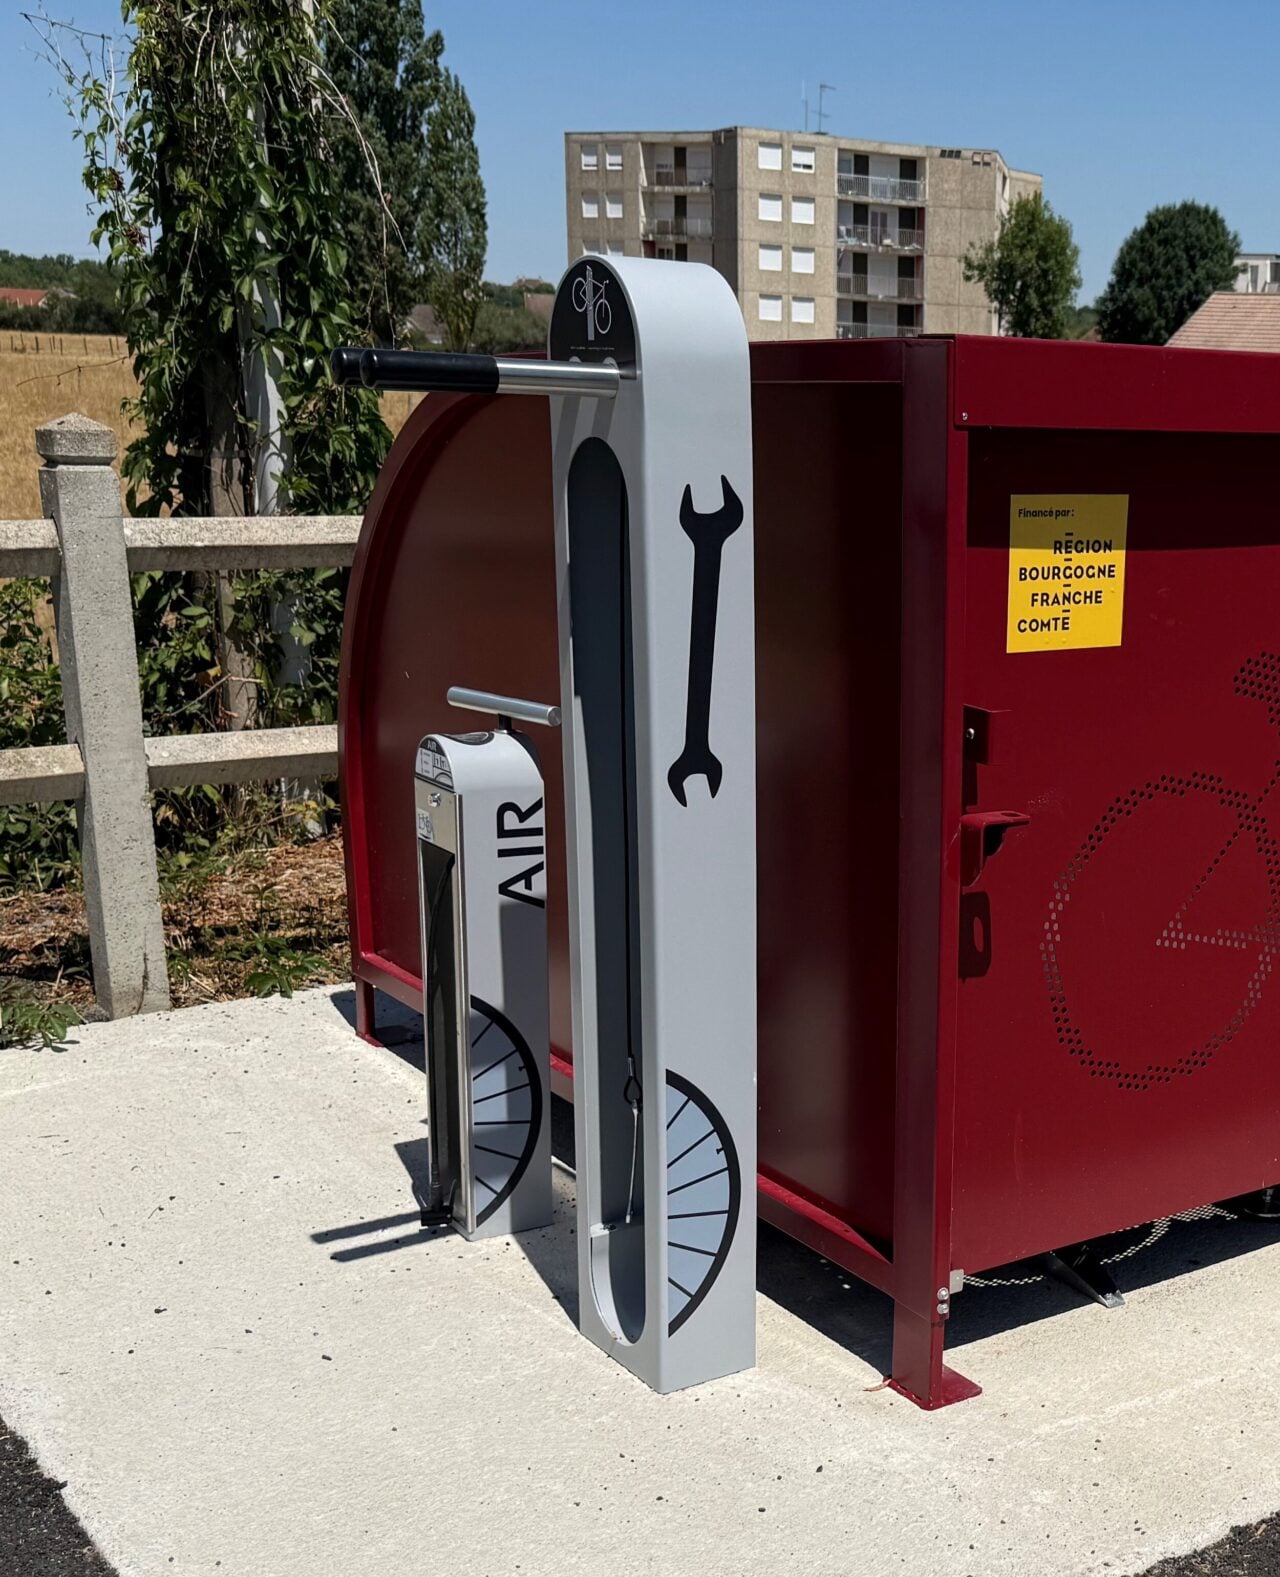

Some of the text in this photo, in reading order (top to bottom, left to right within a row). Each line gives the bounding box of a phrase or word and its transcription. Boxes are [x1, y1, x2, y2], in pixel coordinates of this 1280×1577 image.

[1018, 564, 1116, 582] BOURGOGNE
[1030, 590, 1103, 607] FRANCHE
[496, 797, 545, 909] AIR
